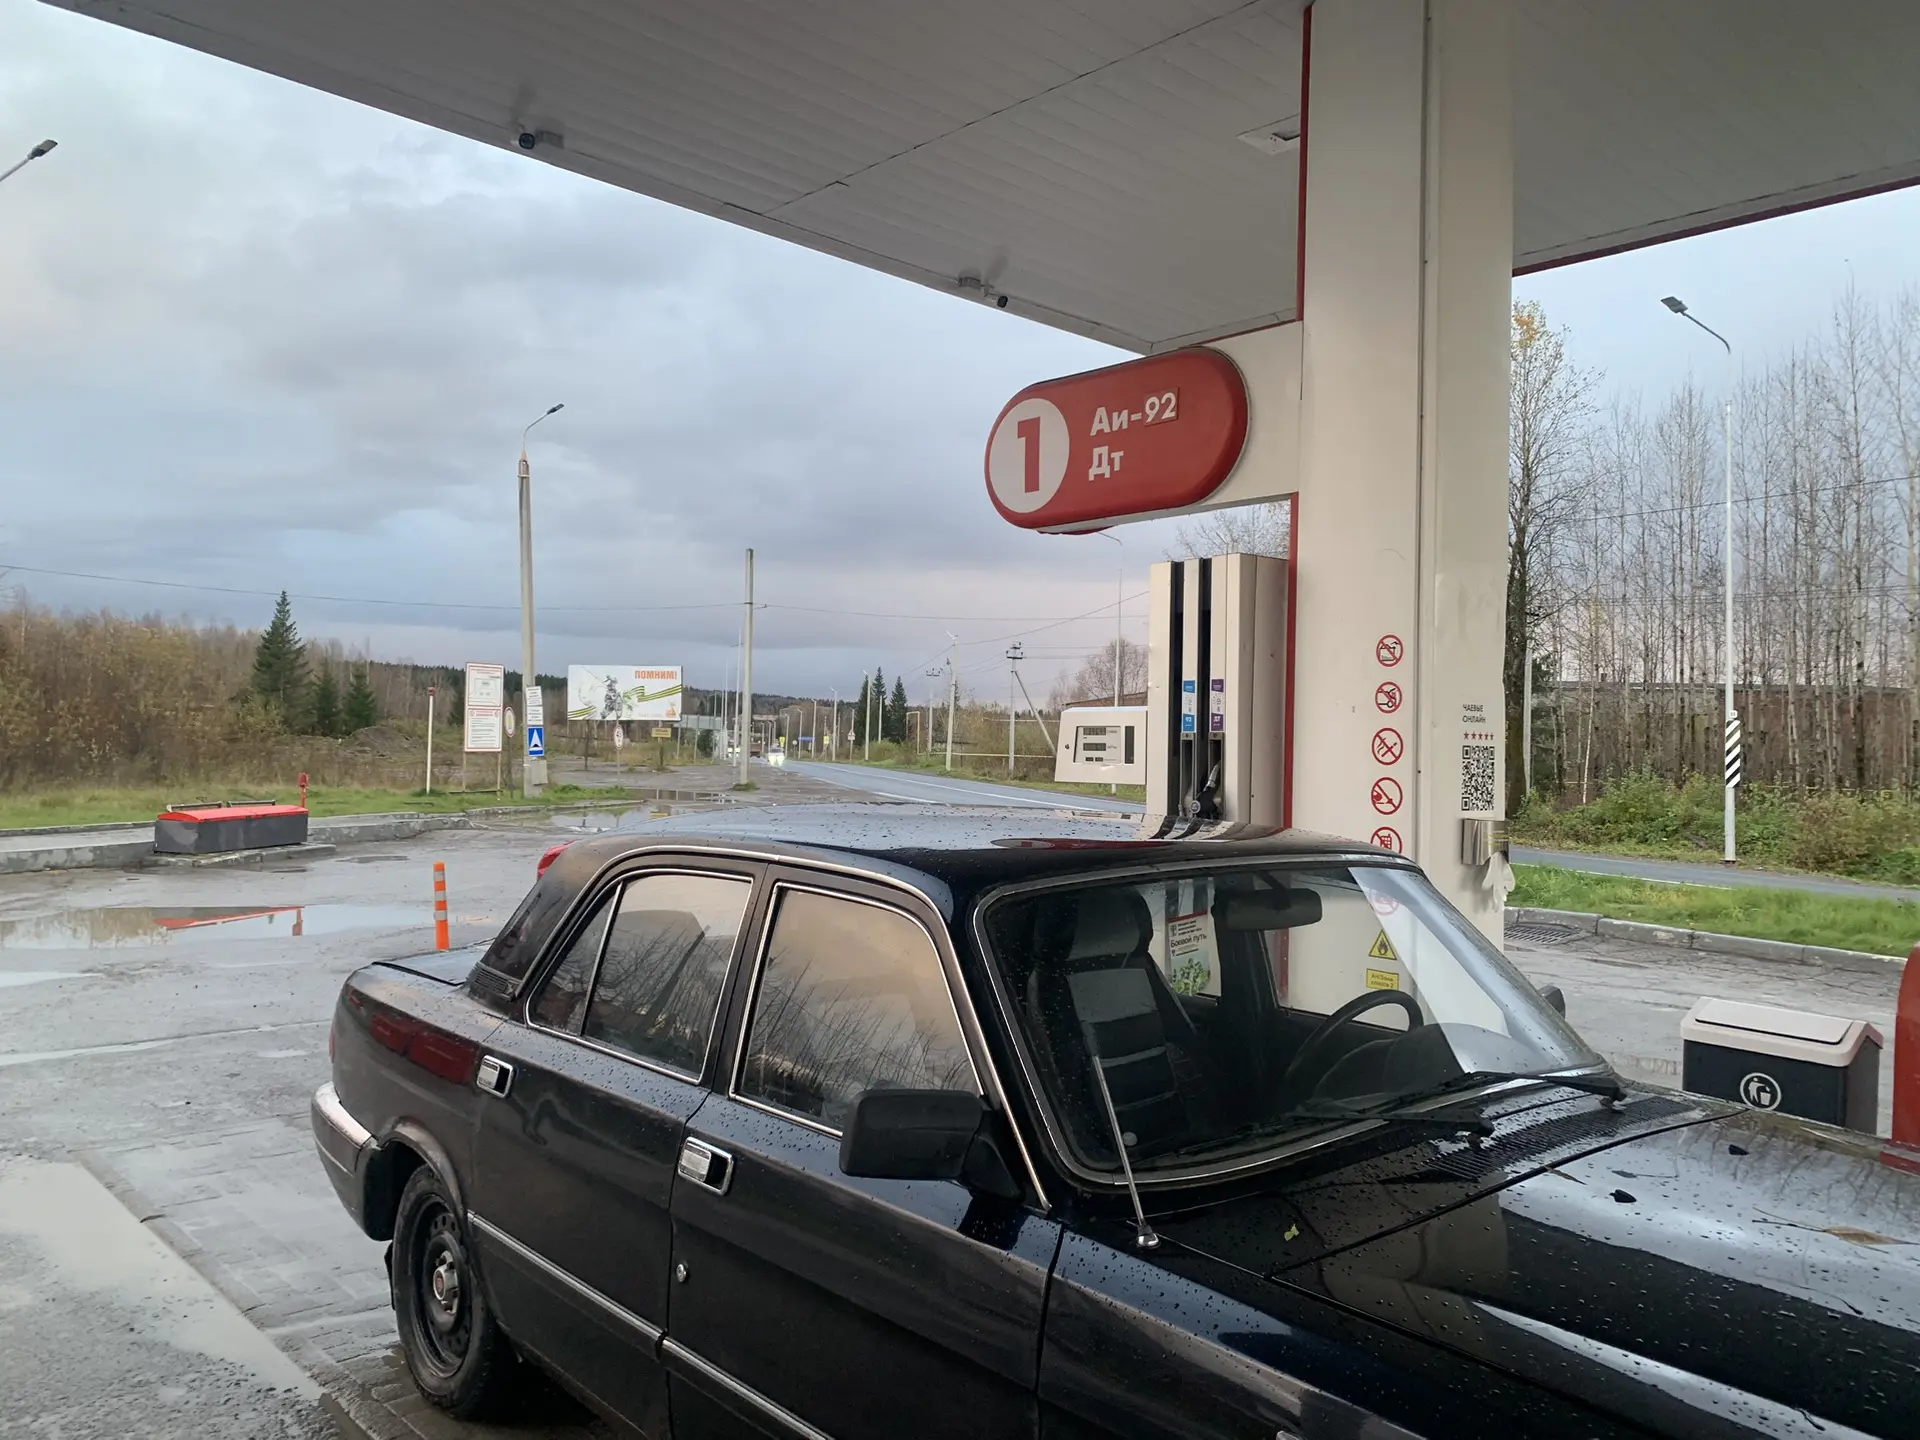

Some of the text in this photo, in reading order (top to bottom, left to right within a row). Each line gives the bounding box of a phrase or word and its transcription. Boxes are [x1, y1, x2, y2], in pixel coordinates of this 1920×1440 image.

[1089, 392, 1177, 437] Аи-92
[1017, 416, 1041, 494] 1
[1088, 445, 1125, 482] Дт
[634, 670, 678, 680] ПОМНИМ!
[1462, 704, 1484, 712] ЧАЕВЫЕ
[1462, 714, 1486, 724] ОНЛАЙН
[1170, 933, 1207, 948] Боевой путь
